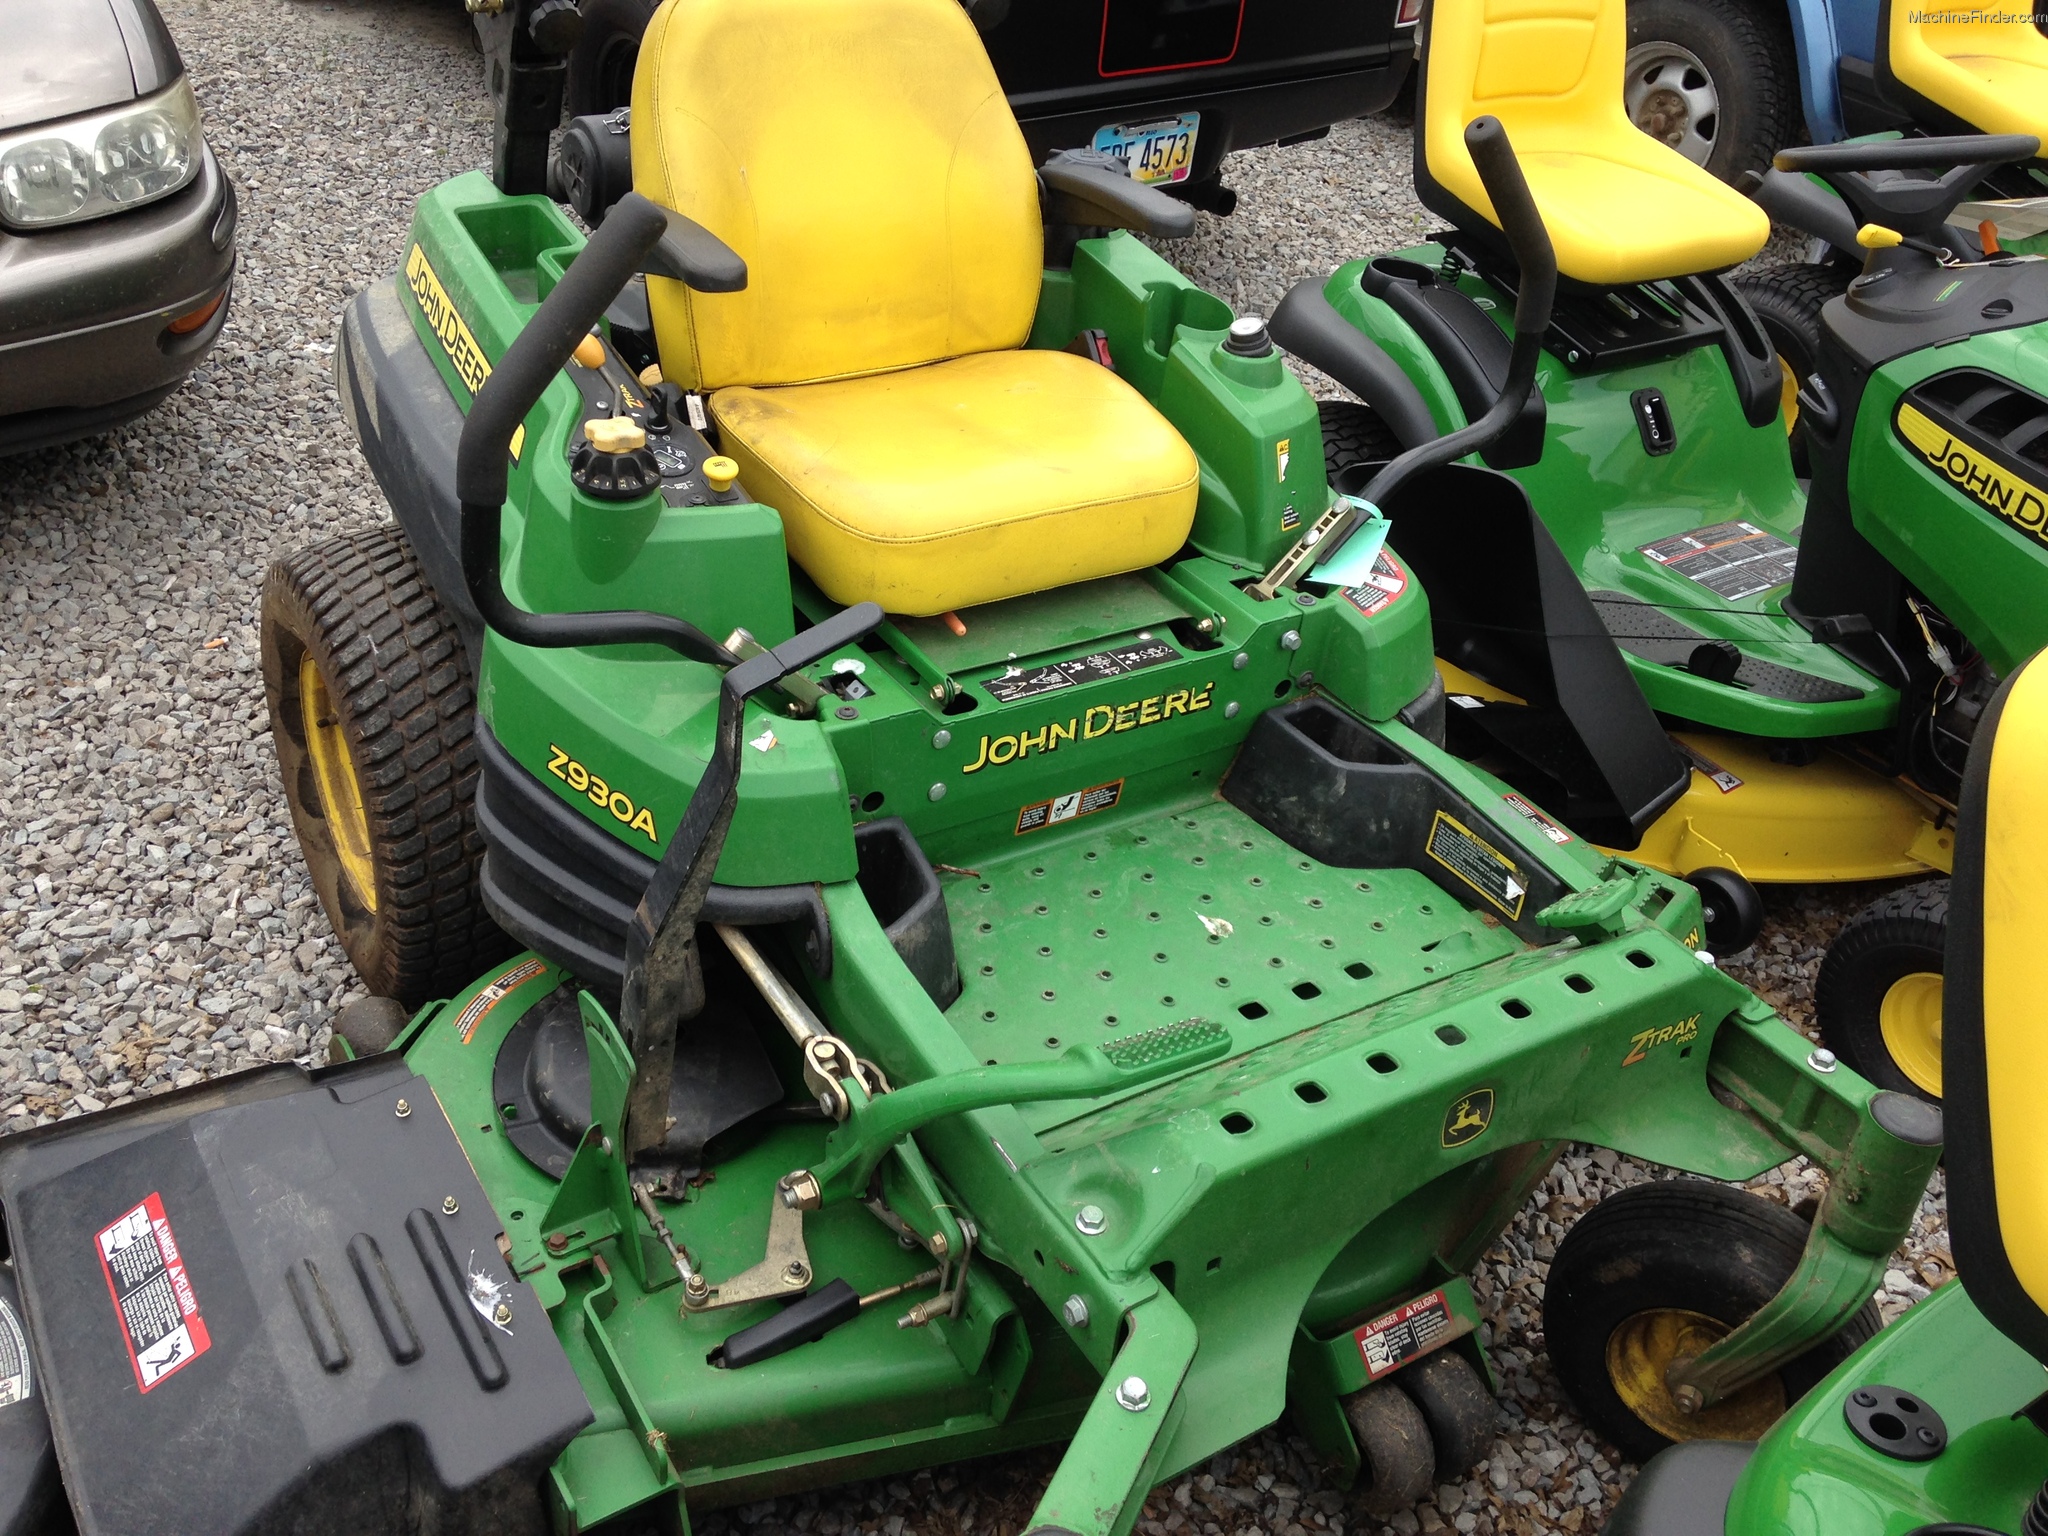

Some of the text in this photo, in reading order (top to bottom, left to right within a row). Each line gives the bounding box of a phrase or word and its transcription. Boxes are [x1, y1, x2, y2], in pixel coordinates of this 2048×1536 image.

[1139, 133, 1189, 172] 4573
[411, 258, 486, 394] JOHN DEER
[1929, 438, 2014, 511] JOHN
[963, 718, 1079, 773] JOHN
[1083, 682, 1215, 740] DEERE
[547, 742, 659, 843] Z930A
[1675, 1030, 1698, 1046] PRO
[156, 1225, 197, 1316] DANGER PELIGRO
[1412, 1293, 1438, 1313] PELIGRO
[1372, 1313, 1399, 1332] DANGER
